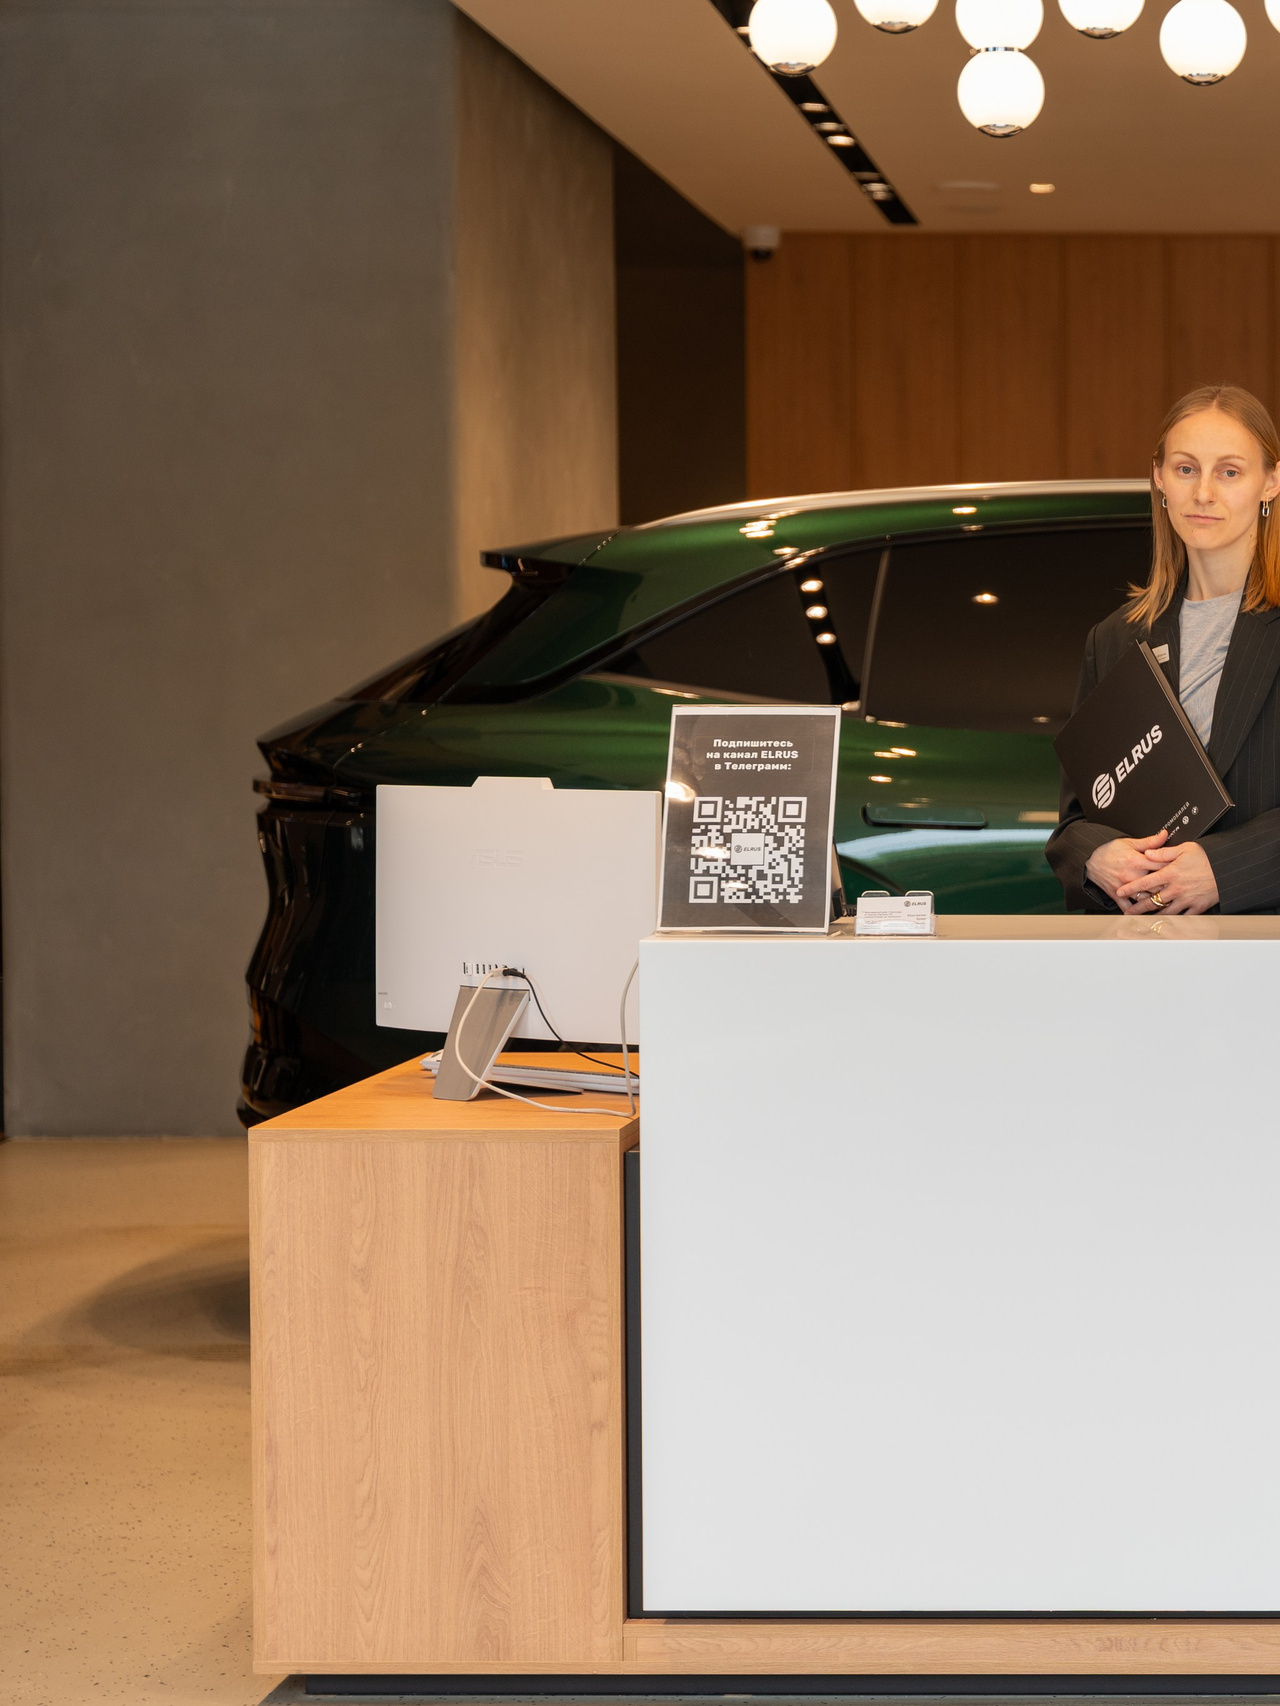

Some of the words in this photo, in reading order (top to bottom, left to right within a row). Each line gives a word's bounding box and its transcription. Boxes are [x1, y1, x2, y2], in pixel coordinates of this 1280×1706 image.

[713, 739, 793, 748] Подпишитесь
[760, 750, 799, 759] ELRUS
[1115, 724, 1163, 783] ELRUS
[724, 762, 792, 771] Телеграмм:
